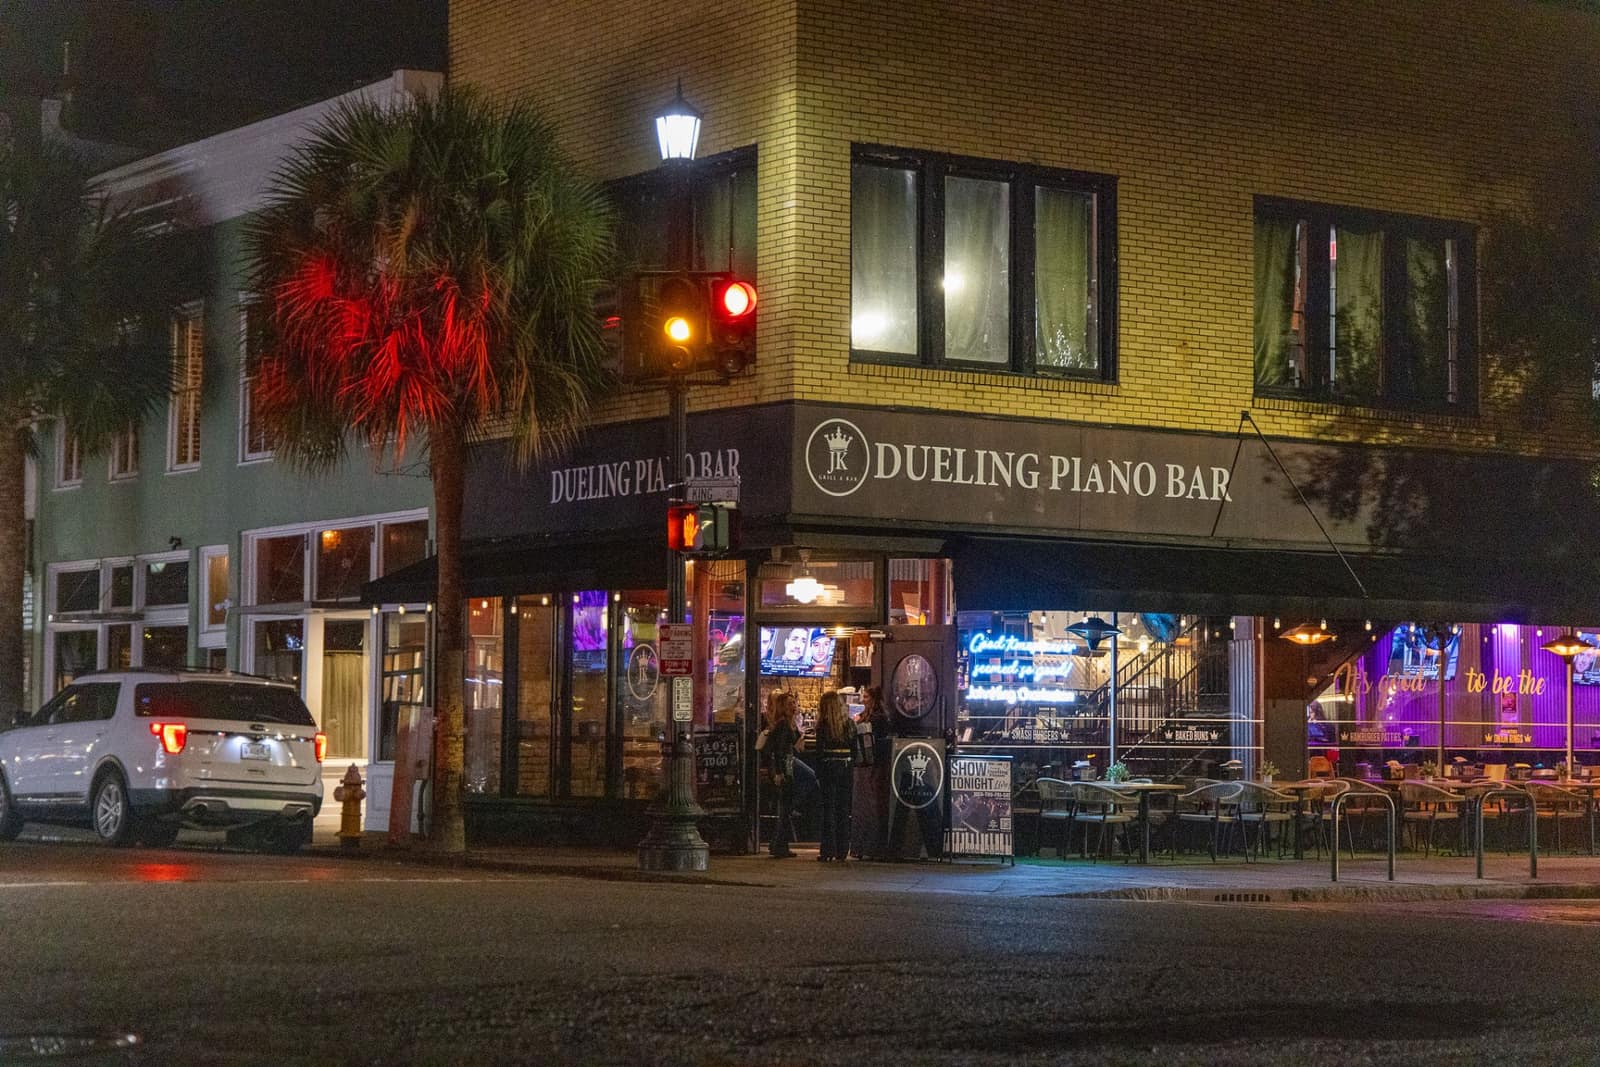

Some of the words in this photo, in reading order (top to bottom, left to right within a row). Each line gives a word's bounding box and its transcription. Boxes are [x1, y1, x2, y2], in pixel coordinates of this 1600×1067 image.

[827, 450, 849, 474] JK
[874, 442, 1041, 488] DUELING
[1049, 455, 1157, 497] PIANO
[1165, 463, 1233, 502] BAR
[551, 461, 631, 504] DUELING
[700, 448, 740, 480] BAR
[692, 488, 713, 500] KING
[970, 633, 1005, 653] Good
[973, 660, 1018, 677] seemed
[1464, 666, 1488, 693] to
[1492, 667, 1514, 695] be
[1516, 668, 1547, 696] the
[1011, 728, 1032, 740] SMASH
[951, 760, 987, 776] SHOW
[908, 768, 924, 791] JK
[951, 777, 994, 790] TONIGHT
